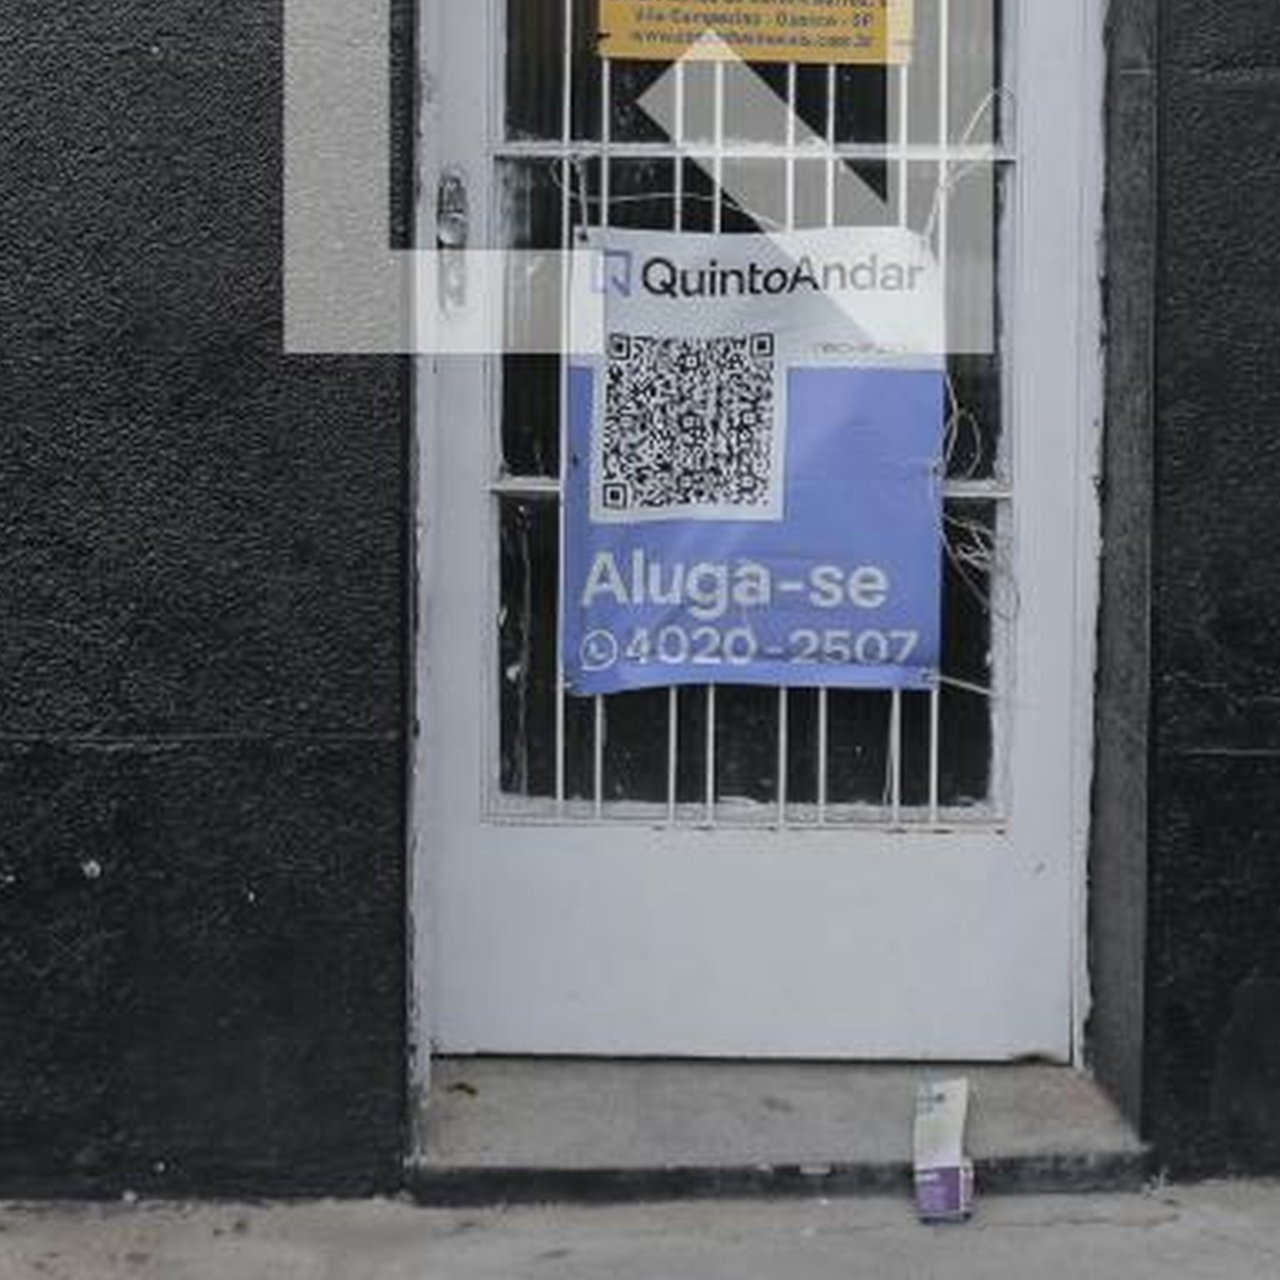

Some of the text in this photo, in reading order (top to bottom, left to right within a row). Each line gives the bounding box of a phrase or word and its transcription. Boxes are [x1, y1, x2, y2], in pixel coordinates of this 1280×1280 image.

[641, 253, 925, 298] QuintoAndar
[582, 548, 891, 618] Aluga-se
[624, 624, 919, 666] 4020-2507
